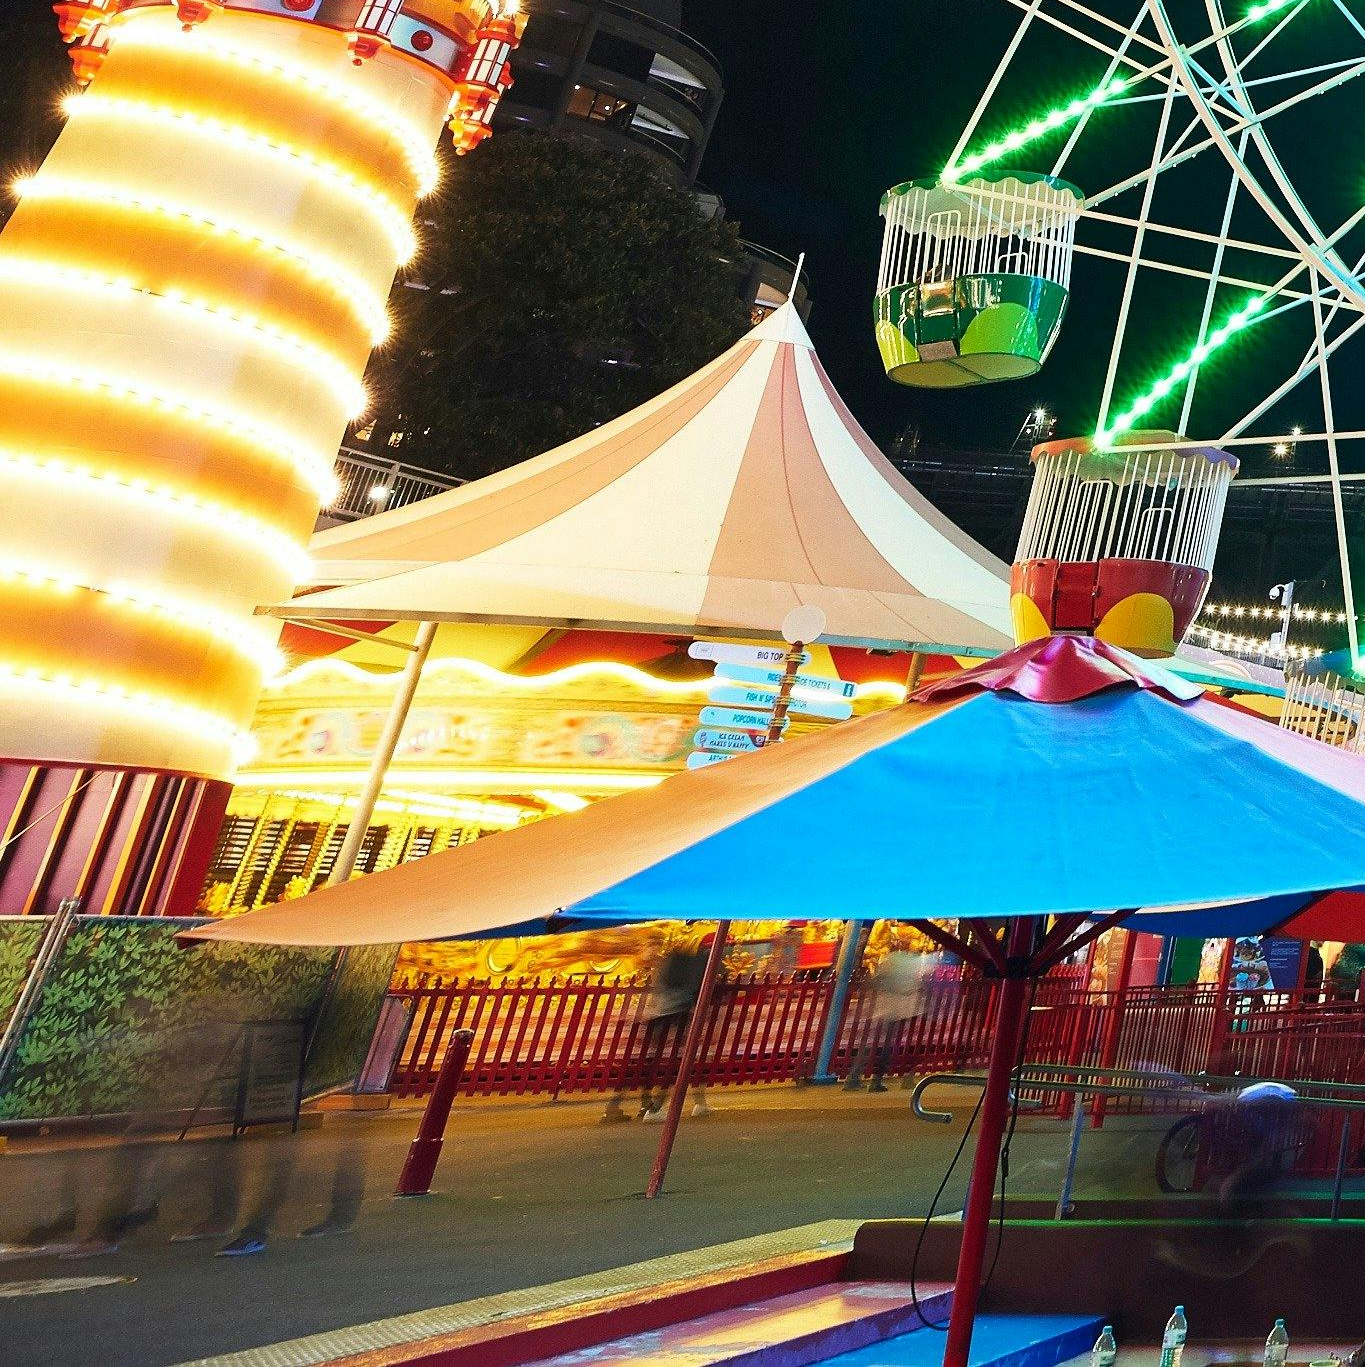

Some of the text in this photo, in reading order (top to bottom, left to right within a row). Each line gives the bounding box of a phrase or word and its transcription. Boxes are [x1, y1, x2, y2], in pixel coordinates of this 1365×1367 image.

[757, 651, 783, 661] BIG TOP
[809, 679, 827, 690] TICKETS
[746, 692, 758, 701] FISH
[732, 713, 756, 724] POPCORN
[719, 732, 745, 741] ICE CREAM
[709, 740, 726, 748] MAKES
